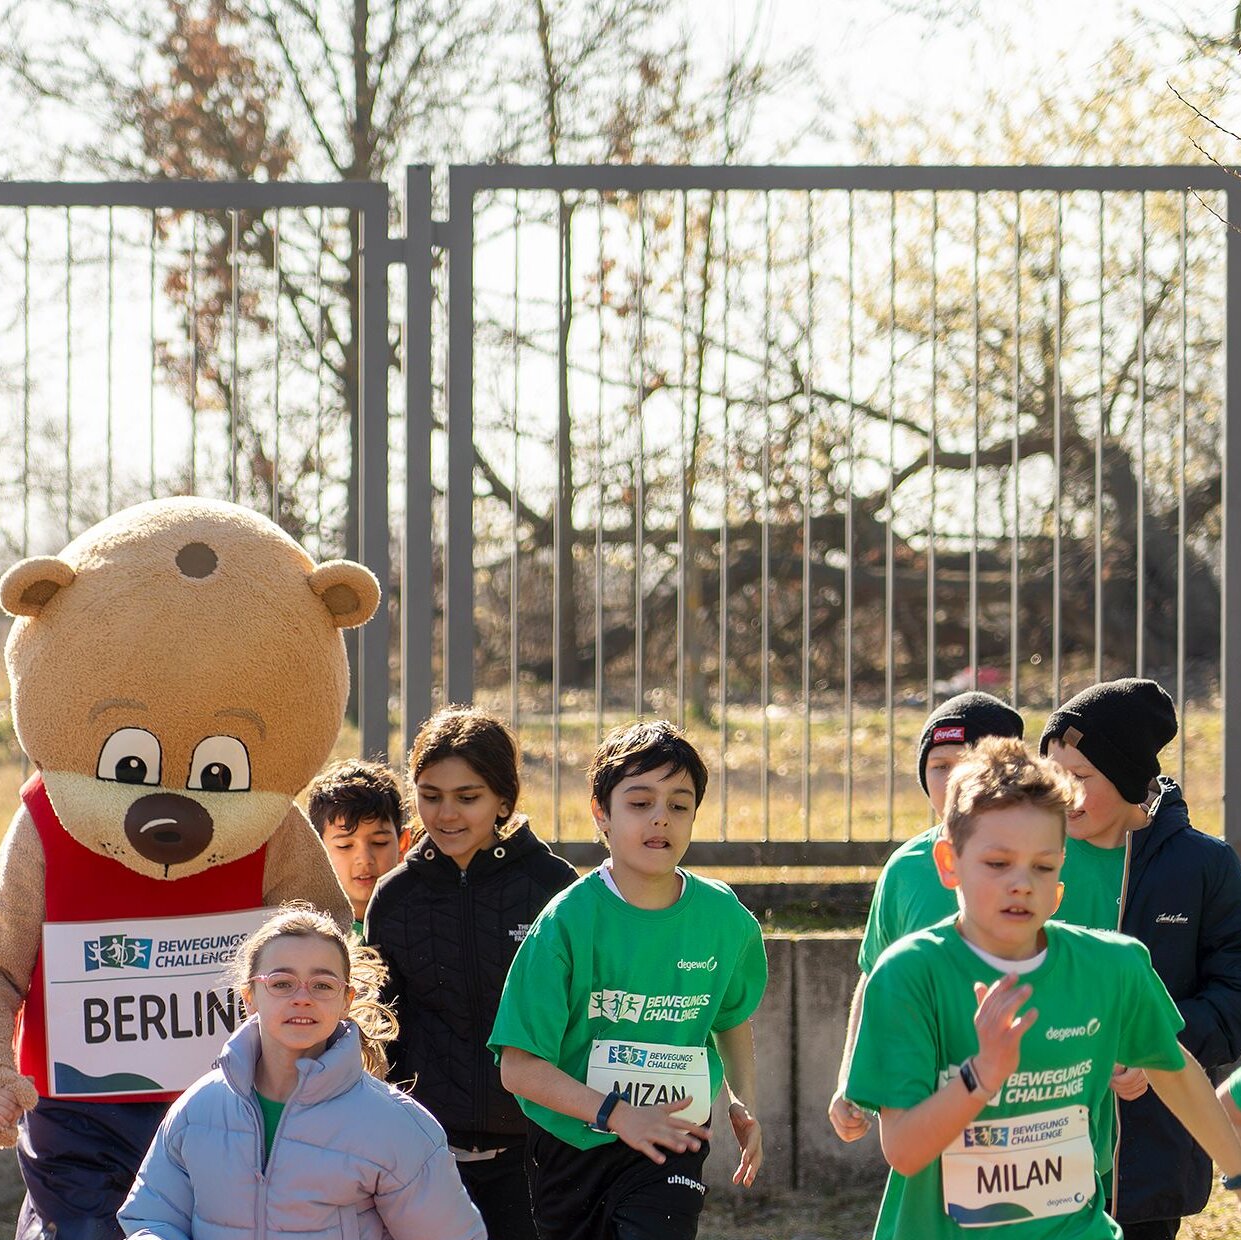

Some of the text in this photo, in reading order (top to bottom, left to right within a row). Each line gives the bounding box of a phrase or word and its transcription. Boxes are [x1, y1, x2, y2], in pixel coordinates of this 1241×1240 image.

[677, 958, 707, 972] degewo
[646, 993, 711, 1009] BEWEGUNGS
[1045, 1026, 1086, 1042] degewo
[646, 1060, 688, 1071] CHALLENGE
[649, 1052, 694, 1063] BEWEGUNGS
[1006, 1059, 1093, 1088] BEWEGUNGS
[1005, 1077, 1084, 1104] CHALLENGE
[1012, 1116, 1069, 1136] BEWEGUNGS
[1010, 1128, 1063, 1146] CHALLENGE
[977, 1155, 1063, 1194] MILAN
